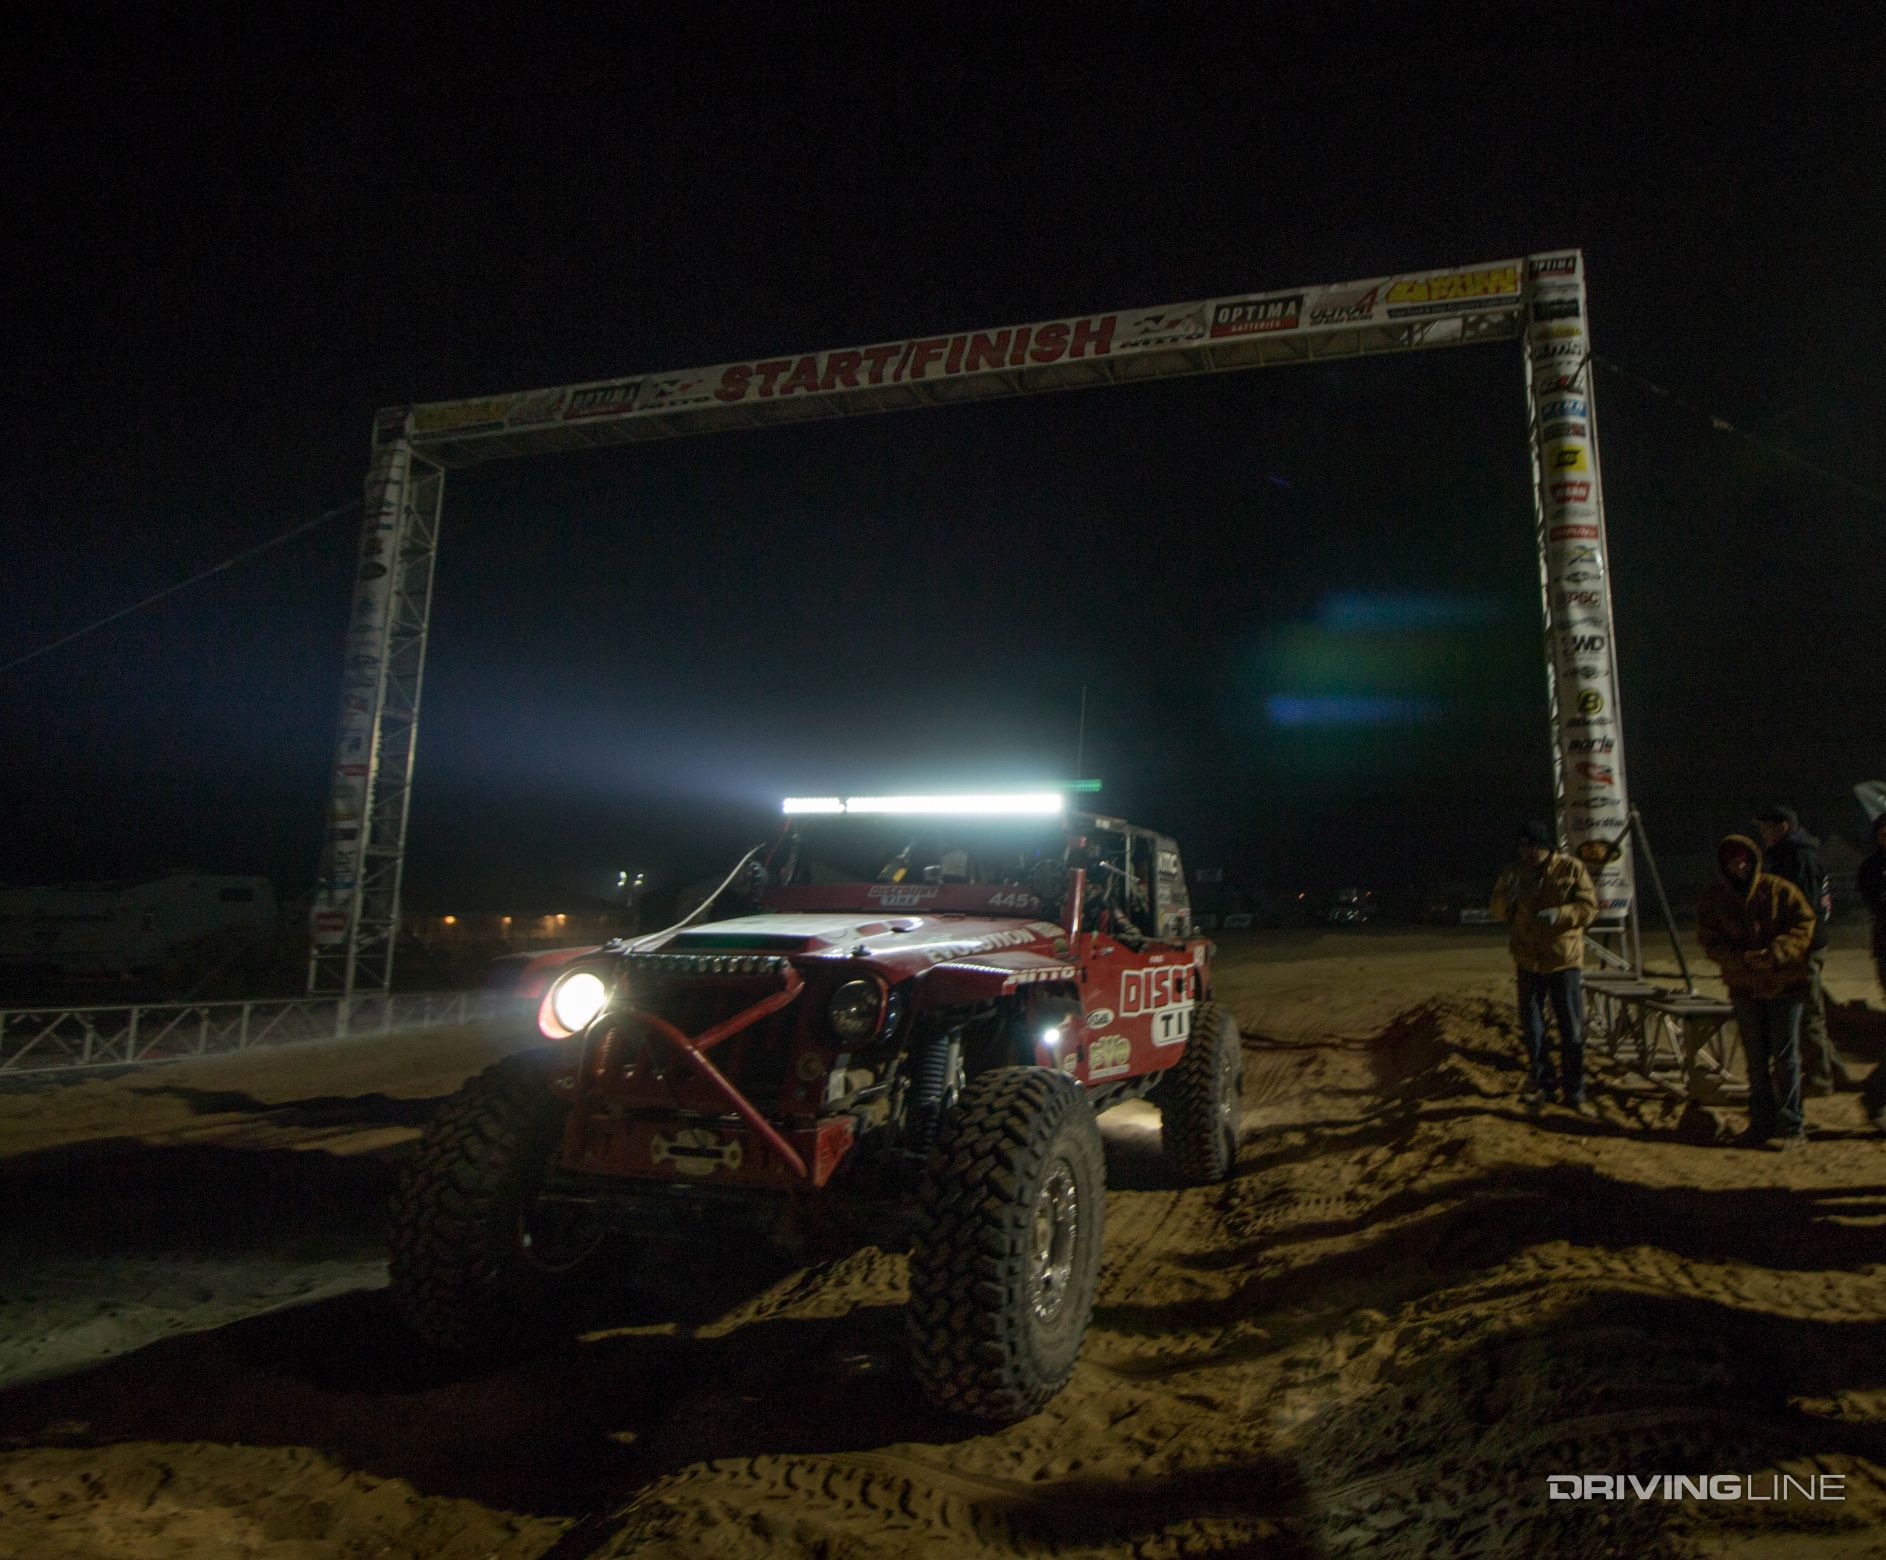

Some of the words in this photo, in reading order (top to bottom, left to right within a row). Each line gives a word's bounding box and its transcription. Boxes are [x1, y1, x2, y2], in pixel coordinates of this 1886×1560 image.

[1218, 300, 1297, 323] OPTIMA
[714, 315, 1118, 402] START/FINISH
[868, 885, 938, 898] DISCOUNT
[926, 928, 1036, 964] EVOLUTION
[1005, 966, 1076, 984] NITTO
[1161, 1009, 1191, 1038] TI
